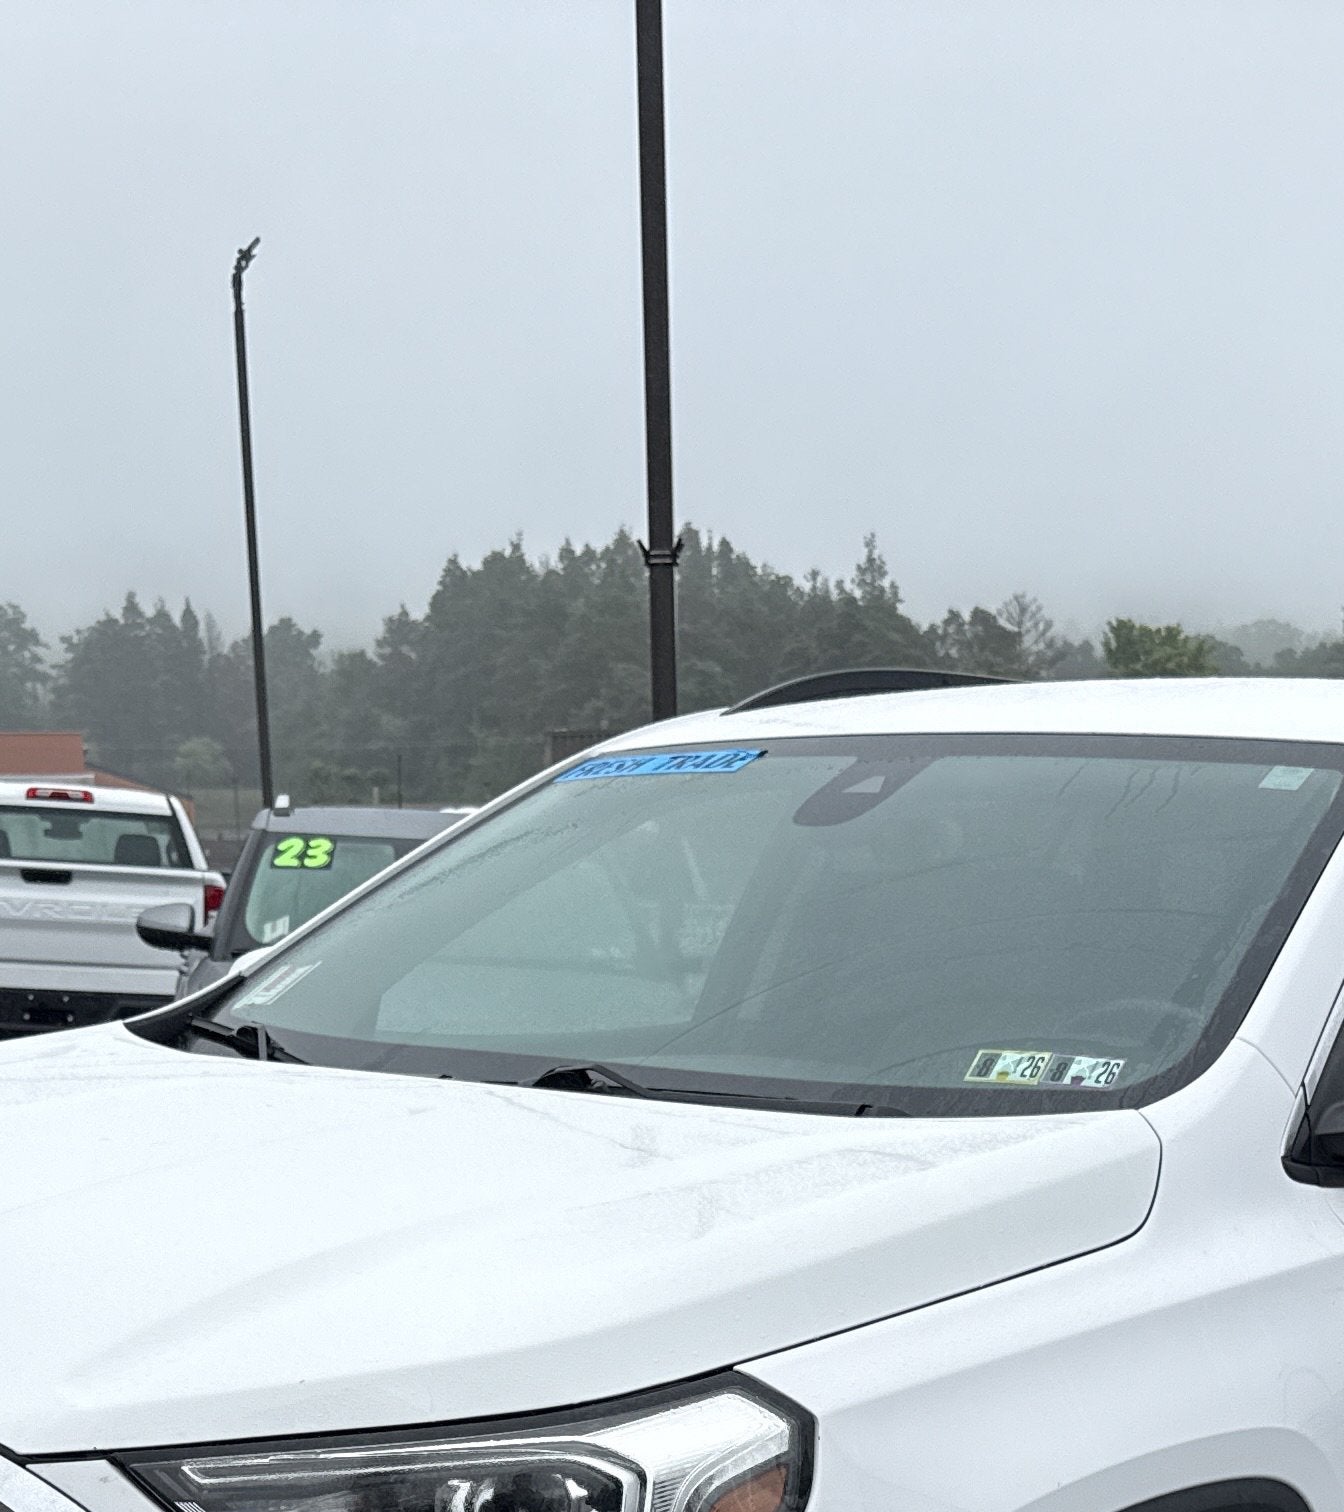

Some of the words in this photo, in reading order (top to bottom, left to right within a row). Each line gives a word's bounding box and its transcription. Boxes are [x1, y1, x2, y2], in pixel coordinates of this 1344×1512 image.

[273, 838, 334, 868] 23
[1020, 1056, 1045, 1079] 26
[1050, 1062, 1069, 1083] 8
[1094, 1062, 1121, 1085] 26
